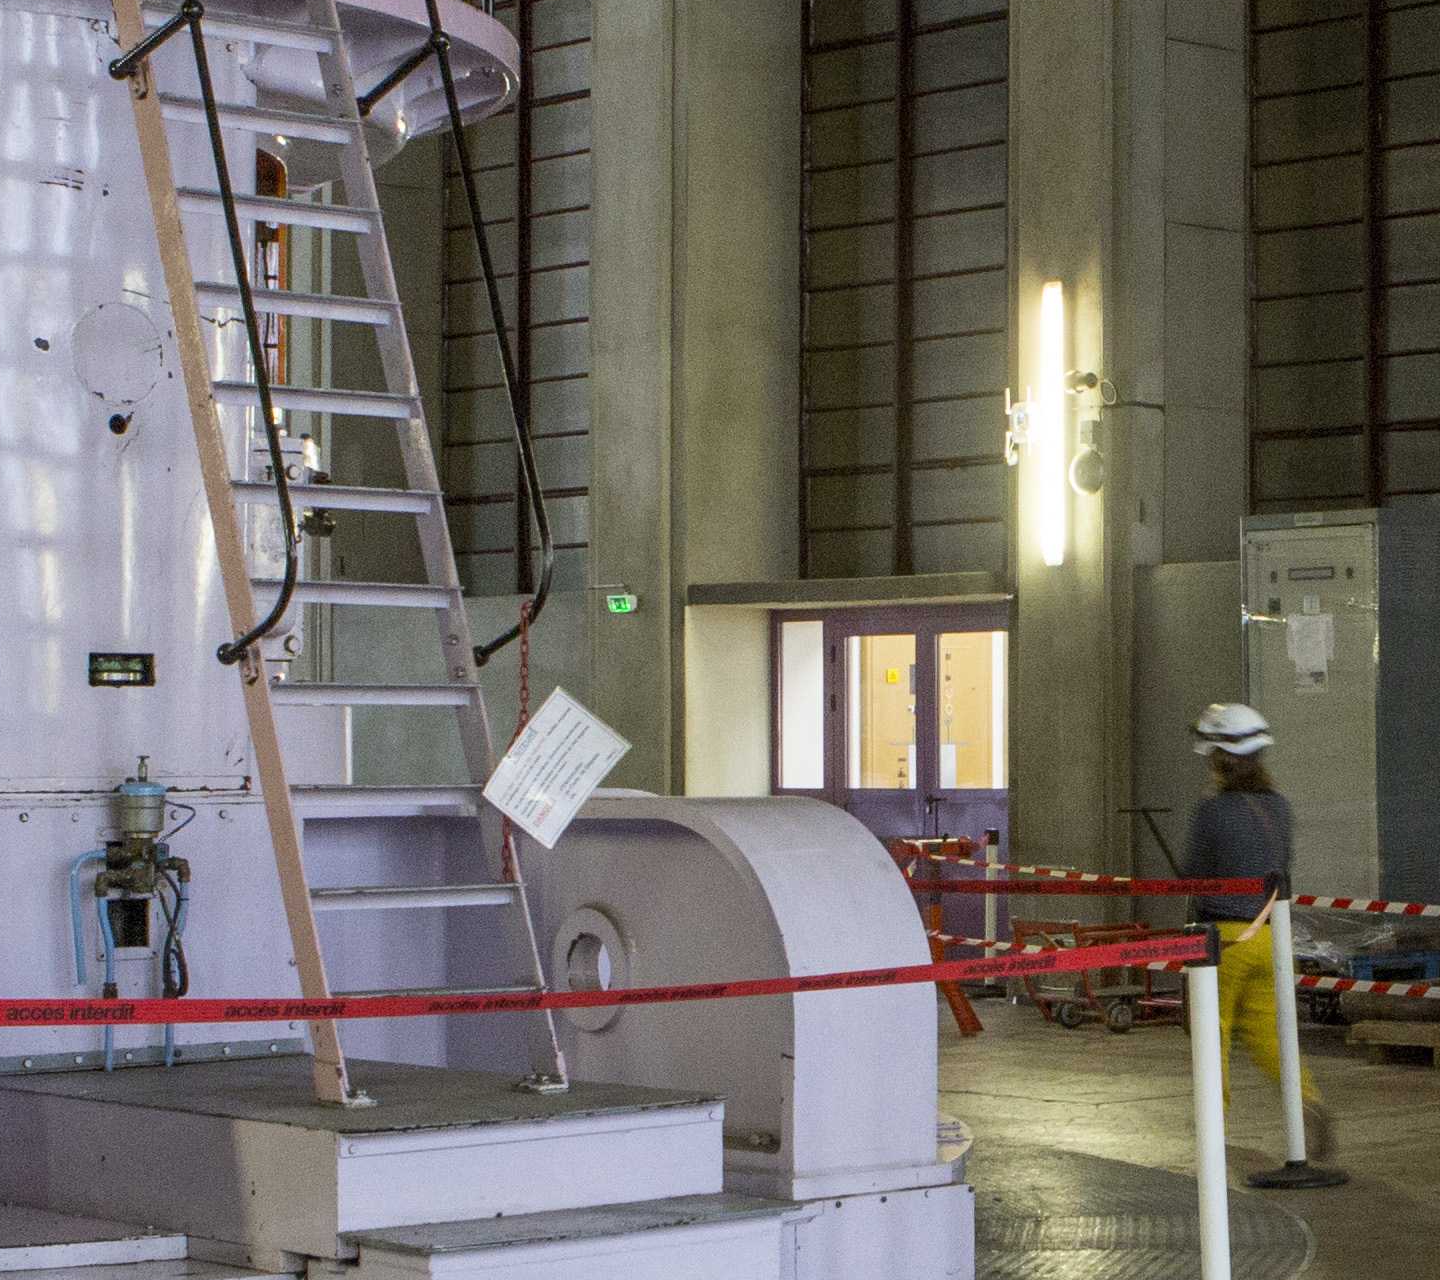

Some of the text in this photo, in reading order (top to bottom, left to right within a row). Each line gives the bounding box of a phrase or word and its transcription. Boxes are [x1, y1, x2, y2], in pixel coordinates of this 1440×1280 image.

[6, 1002, 135, 1022] accès interdit
[224, 1001, 346, 1019] accès interdit
